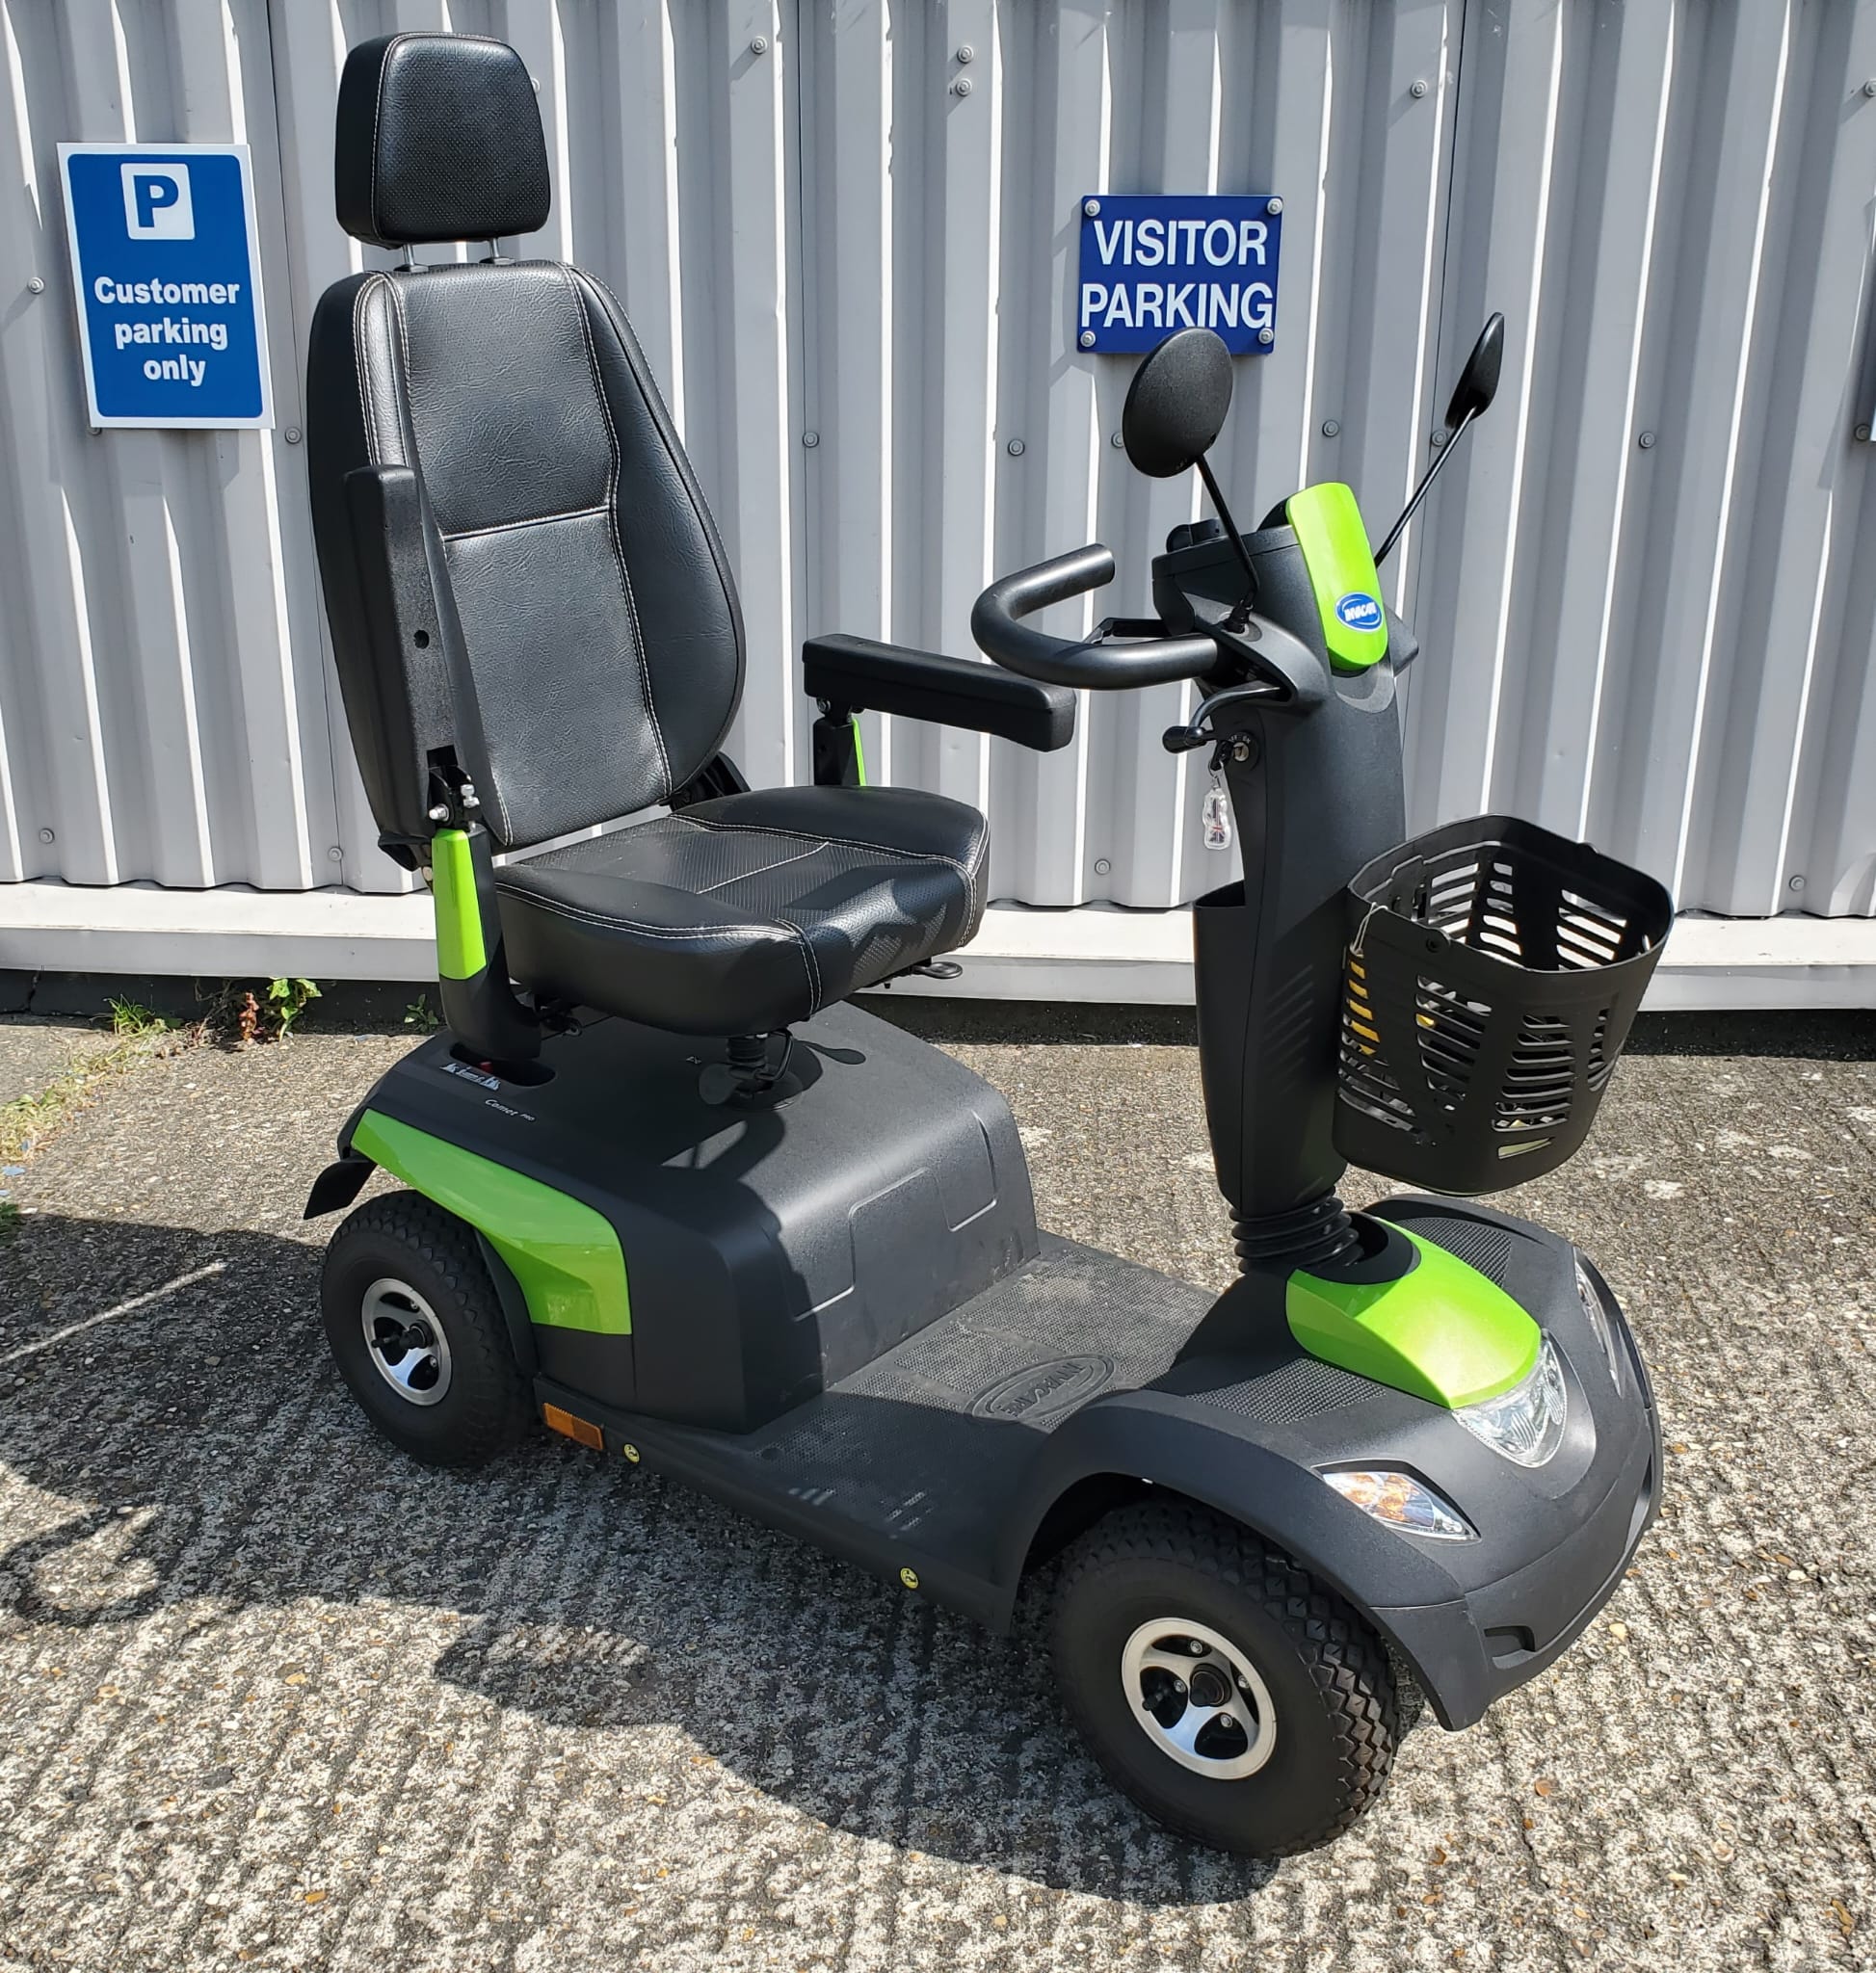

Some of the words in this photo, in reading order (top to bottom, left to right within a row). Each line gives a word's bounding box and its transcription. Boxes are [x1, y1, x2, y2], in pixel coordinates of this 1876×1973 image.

[132, 174, 179, 227] P
[1094, 219, 1268, 266] VISITOR
[93, 276, 240, 303] Customer
[1081, 282, 1274, 329] PARKING
[114, 317, 228, 350] parking
[144, 354, 206, 386] only
[485, 1099, 518, 1116] Comet
